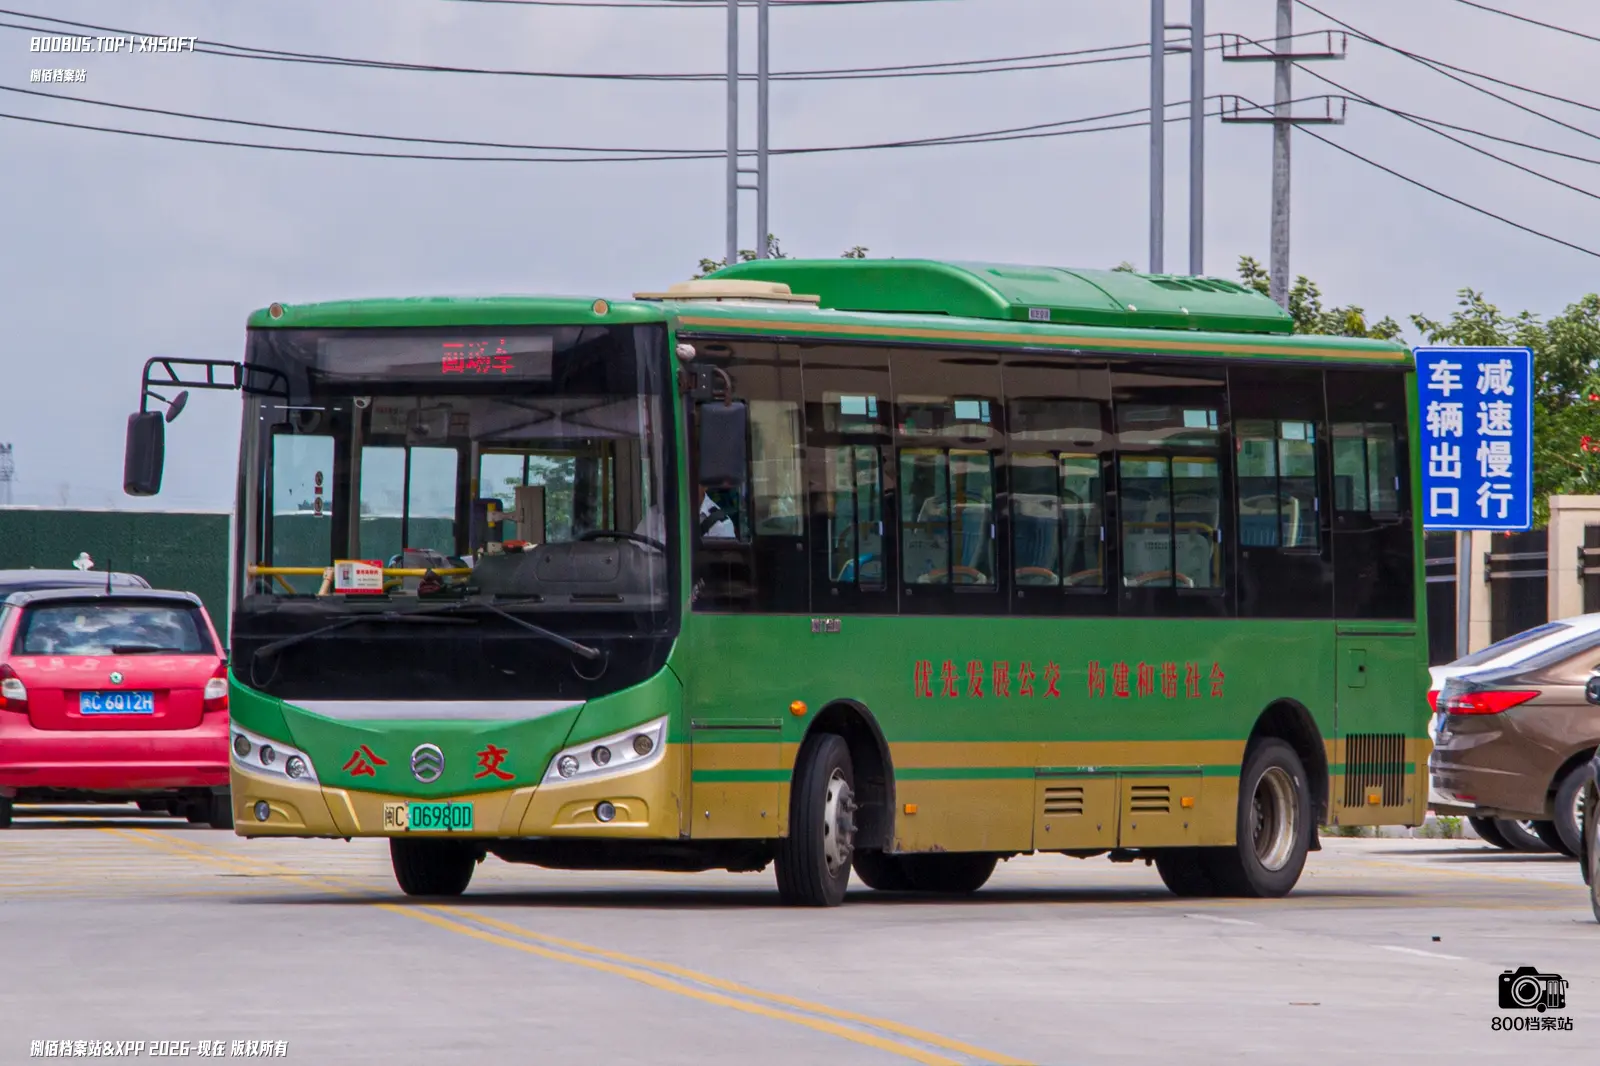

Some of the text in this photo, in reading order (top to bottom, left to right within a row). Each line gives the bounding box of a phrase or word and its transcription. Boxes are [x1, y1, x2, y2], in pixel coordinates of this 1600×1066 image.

[1426, 359, 1464, 519] 车辆出口
[1476, 358, 1515, 519] 减速慢行
[913, 660, 1225, 699] 优先发展公交 构建和谐社会
[342, 744, 516, 781] 公 交
